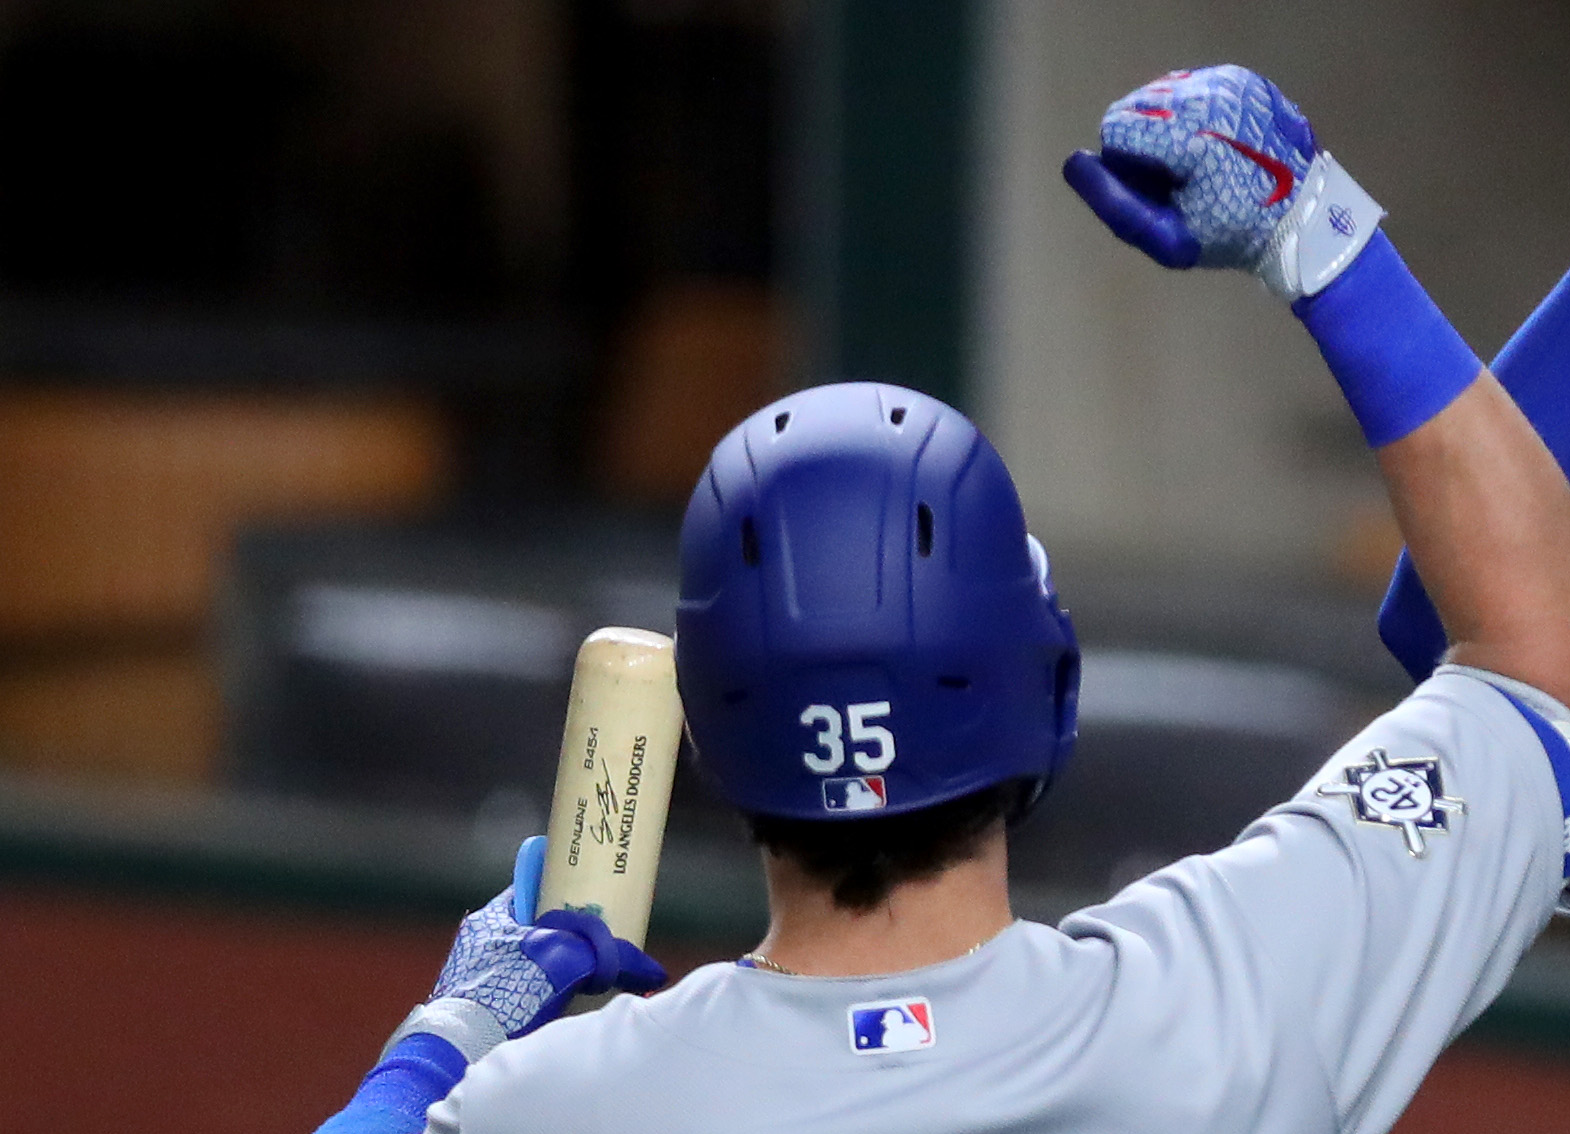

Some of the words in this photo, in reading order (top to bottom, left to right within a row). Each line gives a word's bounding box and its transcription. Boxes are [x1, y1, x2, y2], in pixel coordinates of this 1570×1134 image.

[626, 735, 647, 796] DODGERS
[800, 700, 897, 775] 35
[568, 797, 588, 867] GENUINE
[618, 798, 637, 851] ANGELES
[613, 852, 628, 874] LOS
